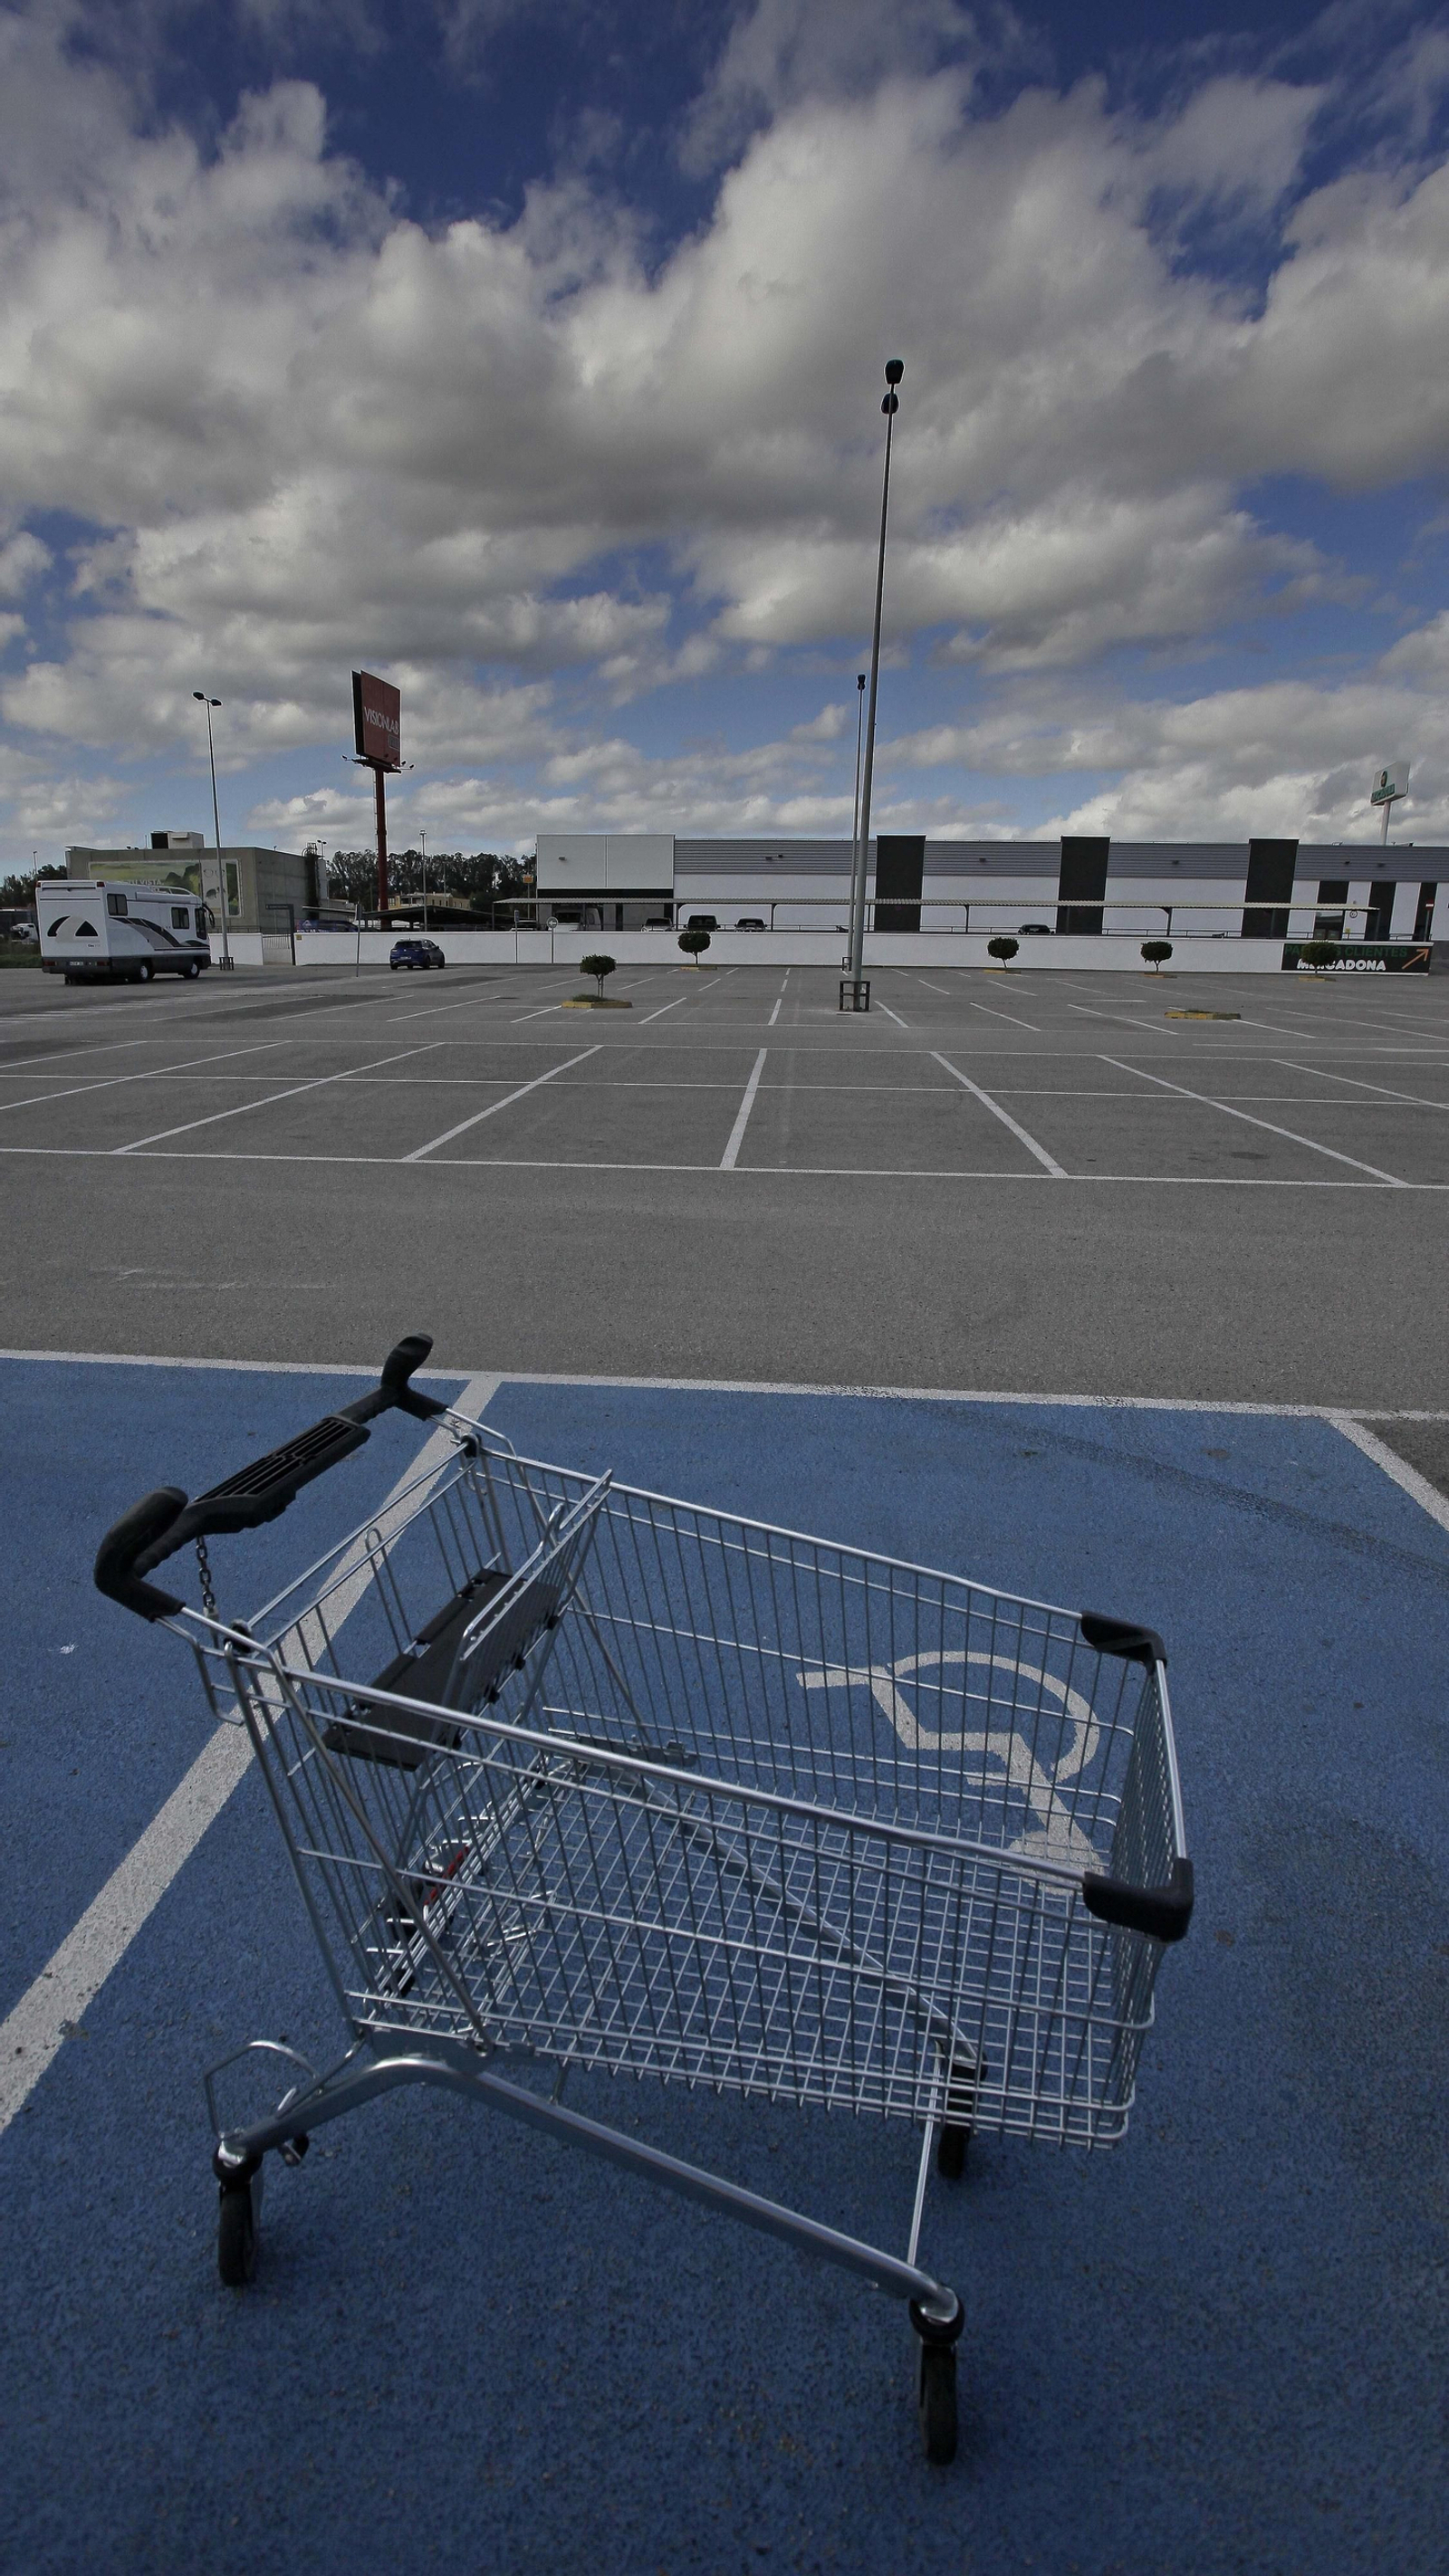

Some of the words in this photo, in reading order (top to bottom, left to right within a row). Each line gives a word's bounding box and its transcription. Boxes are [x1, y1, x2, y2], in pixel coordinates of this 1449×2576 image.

[364, 706, 399, 735] VISIONLAB
[1345, 946, 1408, 958] CLIENTES
[1297, 958, 1387, 972] MCADONA
